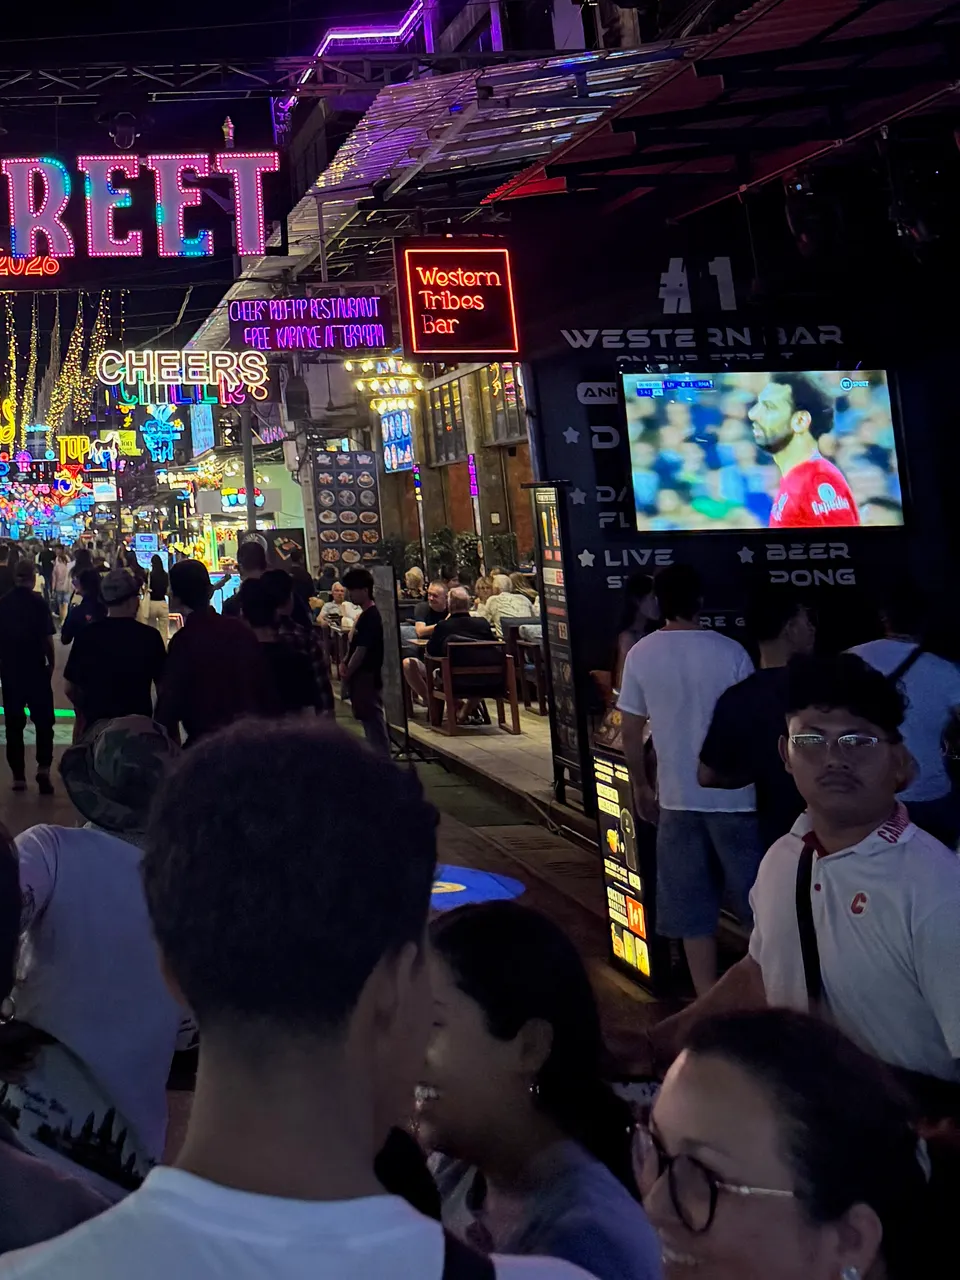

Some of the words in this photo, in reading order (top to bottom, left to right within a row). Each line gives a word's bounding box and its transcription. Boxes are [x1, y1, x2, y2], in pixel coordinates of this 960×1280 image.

[416, 267, 502, 287] Western
[418, 290, 485, 310] Tribes
[229, 300, 267, 322] CHEERS
[421, 314, 460, 334] Bar
[244, 326, 272, 350] FREE
[560, 326, 752, 349] WESTERN
[96, 349, 268, 386] CHEERS
[57, 435, 91, 465] TOP
[604, 548, 676, 567] LIVE
[766, 543, 852, 561] BEER
[770, 569, 856, 587] PONG
[850, 892, 867, 915] C
